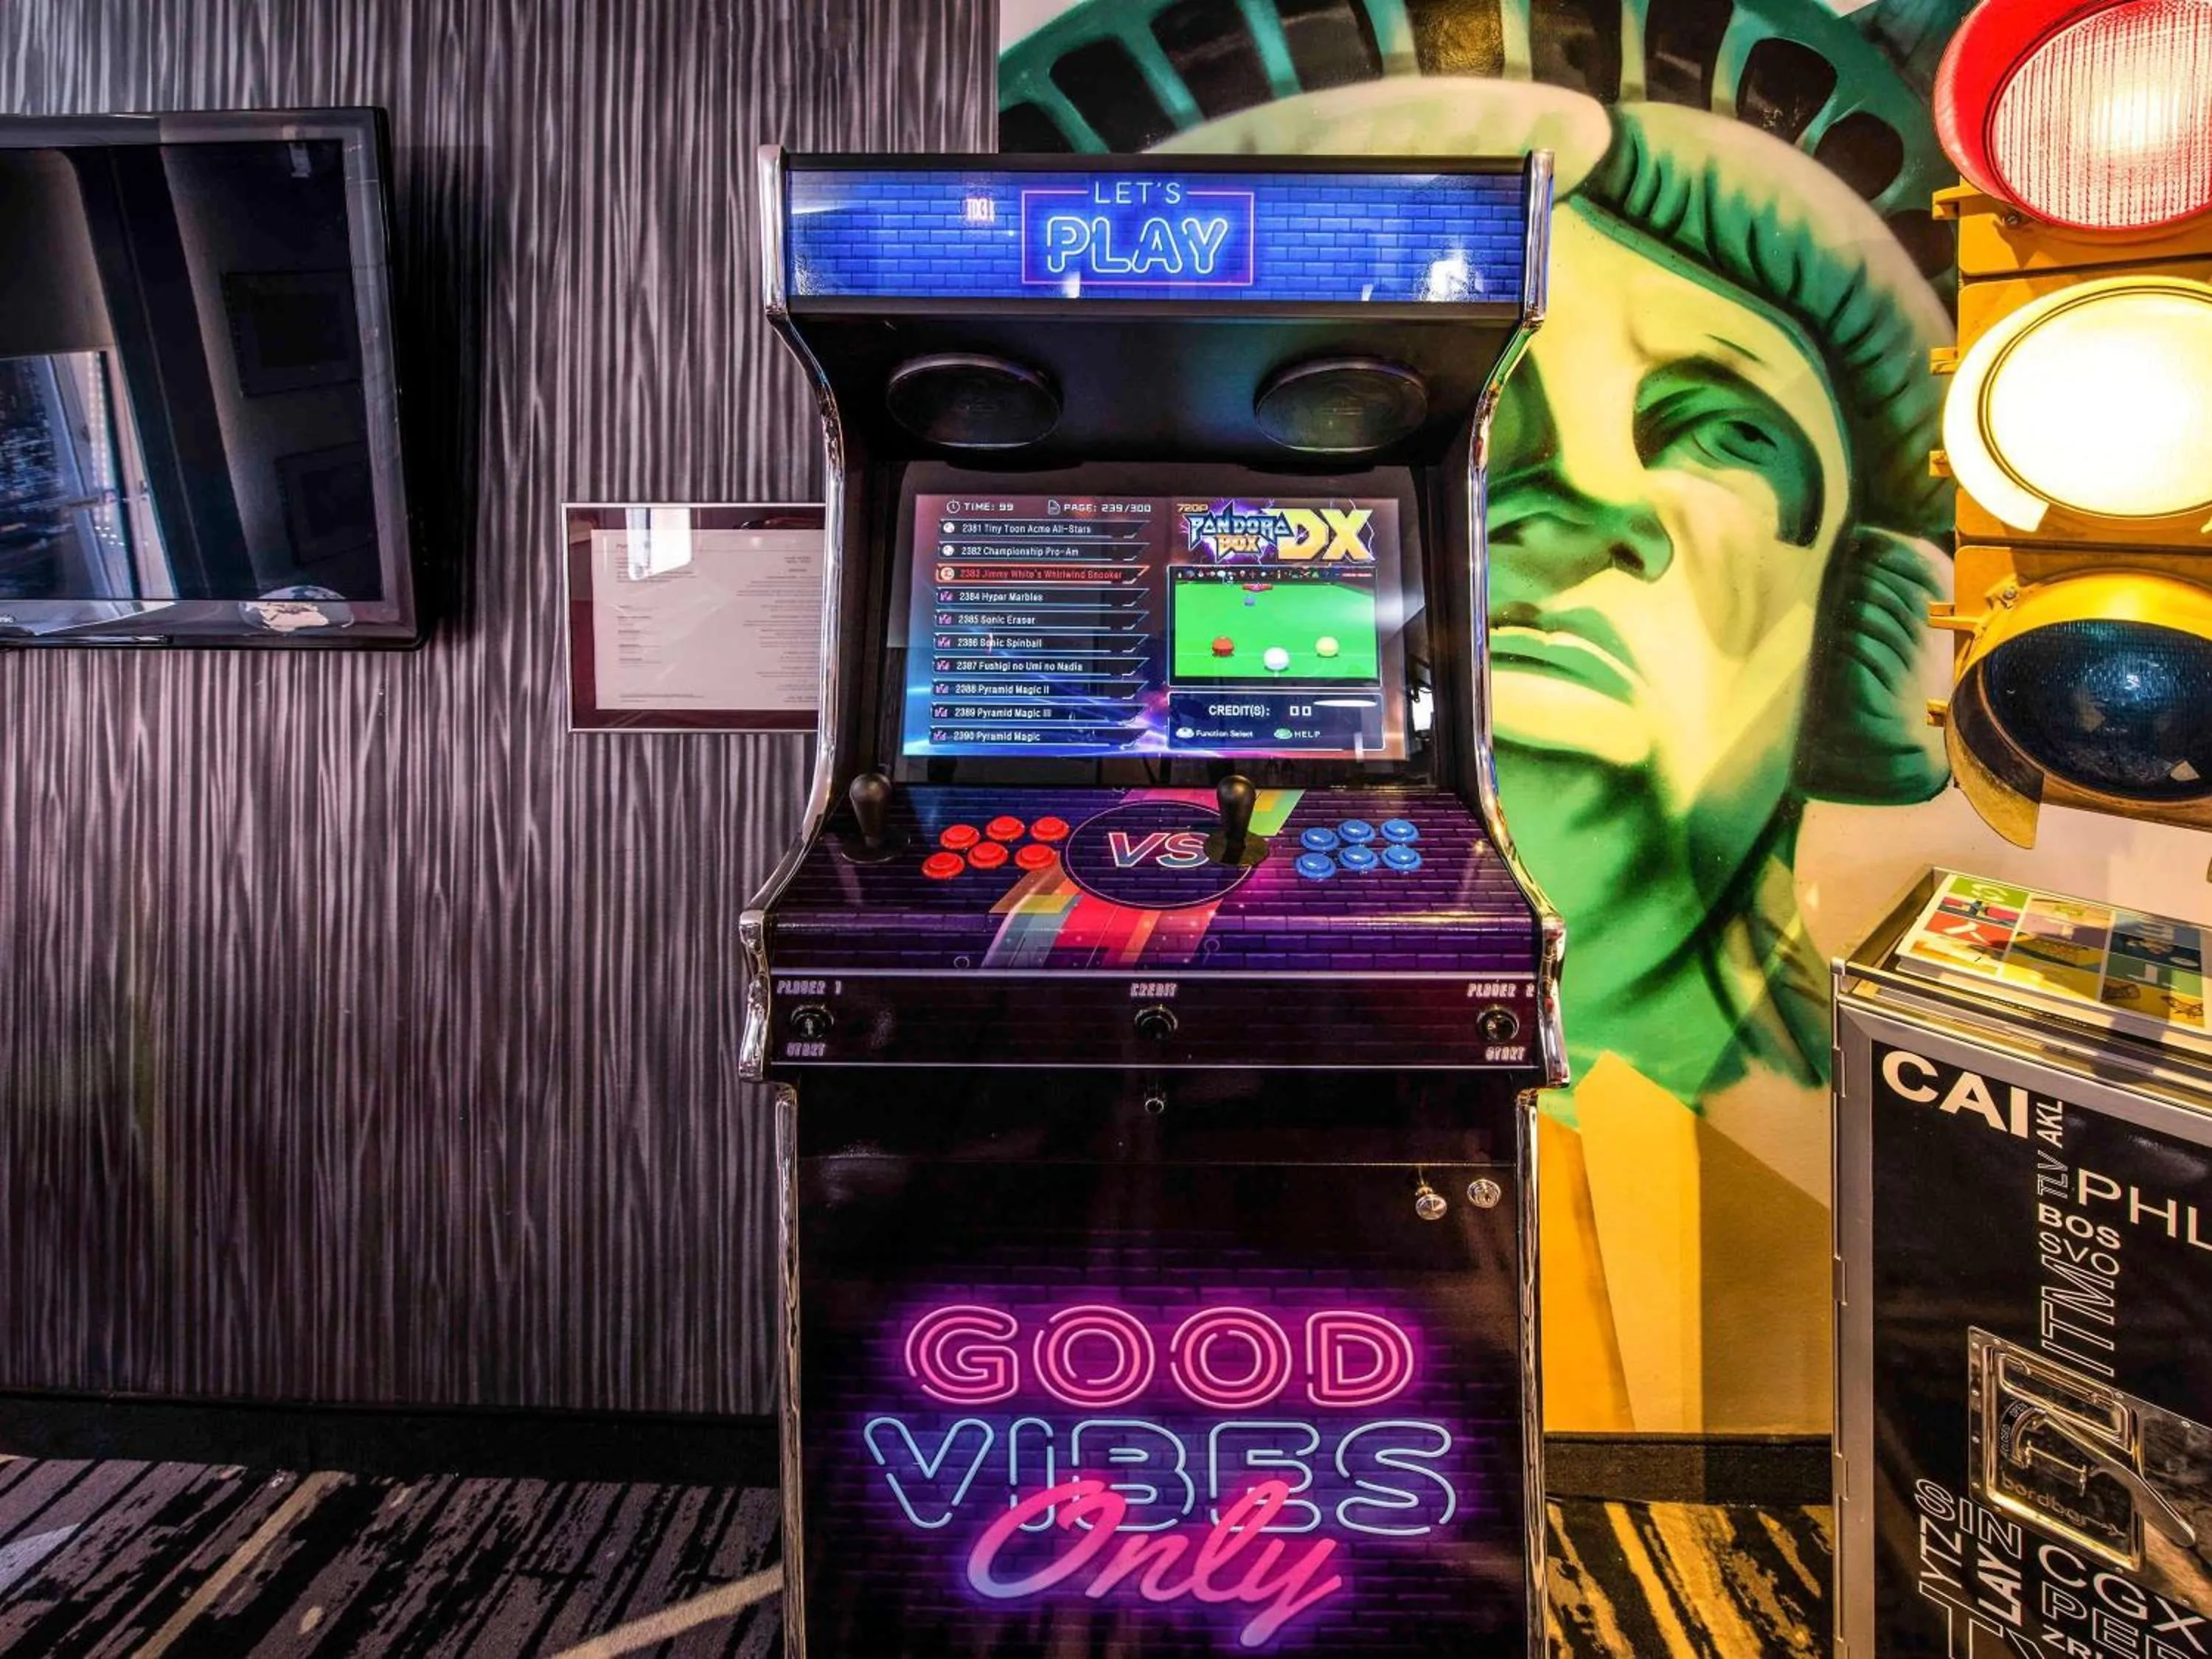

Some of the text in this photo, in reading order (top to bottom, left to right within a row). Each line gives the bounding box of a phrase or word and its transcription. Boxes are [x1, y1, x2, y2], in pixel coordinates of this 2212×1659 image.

[1095, 181, 1180, 204] LET'S
[1047, 216, 1228, 274] PLAY
[964, 502, 995, 511] TIME:
[1064, 504, 1151, 512] PAGE: 239/300
[1178, 504, 1208, 512] 720P
[984, 524, 1002, 535] Tiny
[1004, 524, 1025, 533] Toon
[1027, 524, 1050, 533] Acme
[1052, 525, 1091, 533] All-Stars
[1186, 507, 1293, 559] PANDORA BOX
[1262, 509, 1375, 560] DX
[961, 546, 1079, 557] 2382 Championship Pro-Am
[981, 569, 1009, 580] Jimmy
[959, 592, 1043, 602] 2384 Hyper Marbles
[958, 615, 1035, 625] 2385 Sonic Eraser
[1006, 639, 1042, 648] Spinball
[956, 661, 977, 670] 2387
[978, 661, 1010, 672] Fushigi
[1026, 662, 1042, 670] Umi
[1057, 662, 1082, 671] Nadia
[978, 685, 1013, 695] Pyramid
[1015, 685, 1042, 695] Magic
[954, 708, 975, 717] 2389
[977, 708, 1012, 718] Pyramid
[1014, 709, 1040, 718] Magic
[1208, 705, 1270, 717] CREDIT(S):
[976, 731, 1012, 742] Pyramid
[1014, 732, 1040, 742] Magic
[1195, 729, 1253, 737] Function Select
[1109, 832, 1211, 868] VS
[1882, 1051, 2028, 1139] CAI
[2036, 1101, 2063, 1149] AKL
[2037, 1150, 2068, 1199] TLV
[2078, 1168, 2212, 1251] PHL
[2039, 1203, 2121, 1250] BOS
[2039, 1231, 2120, 1275] SVO
[905, 1304, 1413, 1408] GOOD
[864, 1417, 1457, 1534] VIBES
[1914, 1479, 2023, 1559] SIN
[967, 1479, 1343, 1647] Only
[2039, 1545, 2209, 1655] CGX
[2042, 1624, 2104, 1659] ZR
